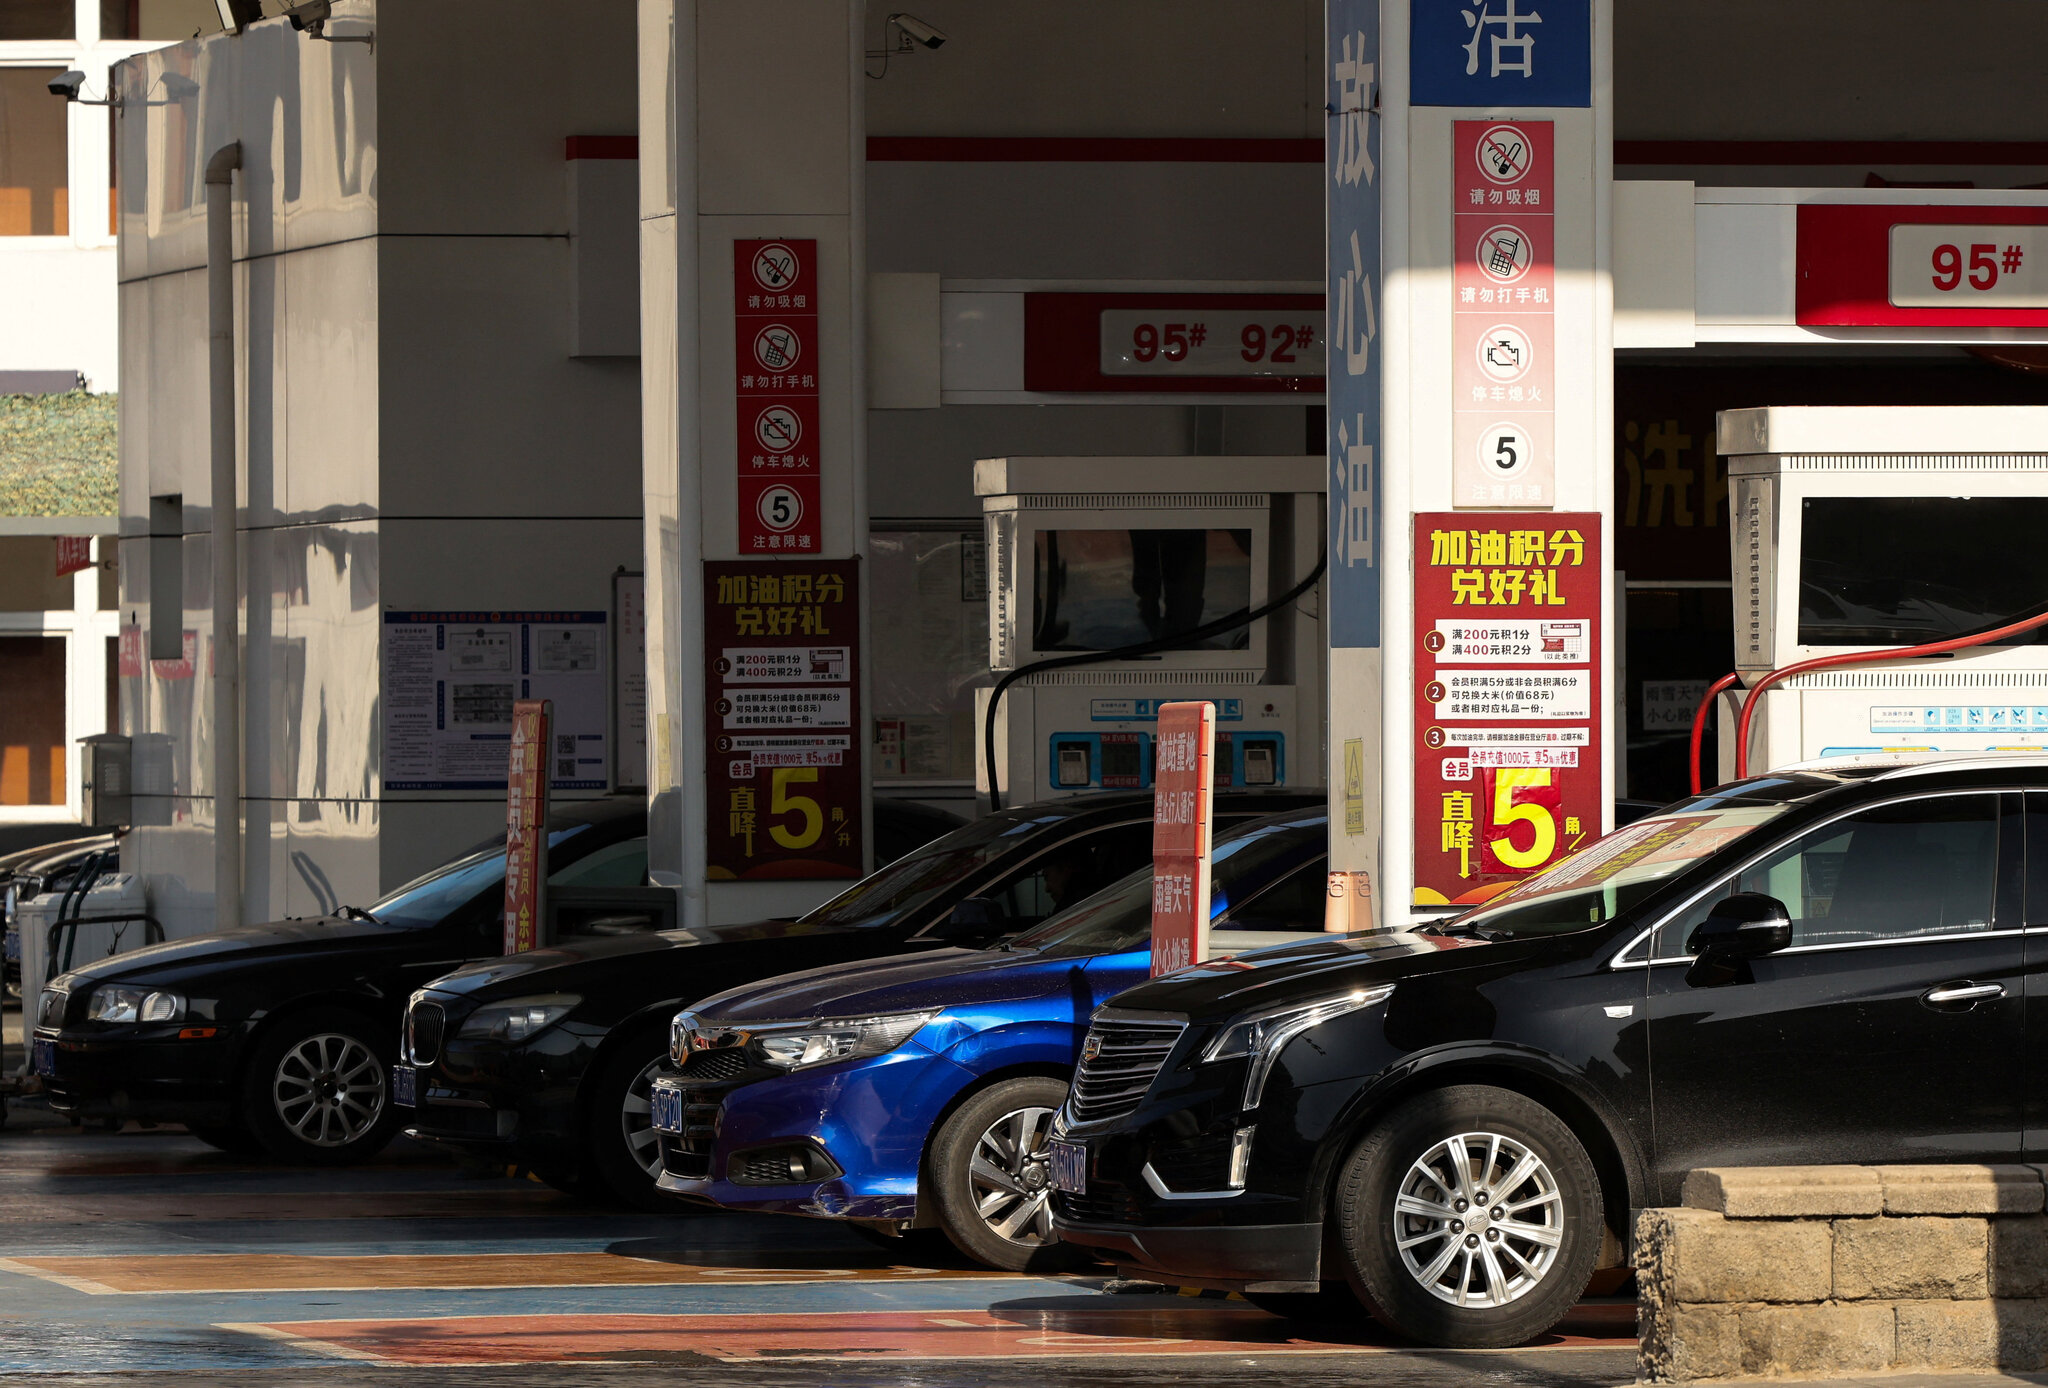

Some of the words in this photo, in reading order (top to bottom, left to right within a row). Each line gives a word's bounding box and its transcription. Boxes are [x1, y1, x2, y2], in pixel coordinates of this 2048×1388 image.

[1470, 188, 1541, 206] 请勿吸烟
[1931, 243, 2024, 291] 95#
[747, 293, 807, 309] 请勿吸烟
[1335, 30, 1376, 568] 放心油
[1460, 286, 1550, 304] 请勿打手机
[1133, 323, 1207, 363] 95#
[1241, 324, 1314, 363] 92#
[742, 374, 816, 390] 请勿打手机
[1471, 385, 1543, 403] 停车熄火
[751, 453, 811, 470] 停车熄火
[1495, 436, 1517, 470] 5
[1471, 484, 1544, 501] 注意限速
[772, 496, 790, 523] 5
[752, 532, 812, 549] 注意限速
[1430, 529, 1586, 567] 加油积分
[717, 573, 845, 605] 加油积分
[1451, 568, 1568, 605] 兑好礼
[735, 606, 831, 636] 兑好礼
[1451, 630, 1531, 641] 满200元积1分
[1451, 645, 1533, 656] 满400元积2分
[736, 655, 801, 665] 满200元积1分
[736, 667, 803, 678] 满400元积2分
[1450, 677, 1578, 688] 会员积满5分或非会员积满6分
[1450, 690, 1555, 702] 可兑换大米(价值68元)
[1646, 706, 1699, 723] 小心路
[1470, 751, 1530, 765] 会员充值1000元
[732, 763, 753, 777] 会员
[1445, 761, 1470, 778] 会员
[769, 767, 823, 849] 5
[729, 786, 757, 859] 直降
[1489, 768, 1557, 869] 5
[1441, 790, 1473, 879] 直降
[1154, 873, 1193, 916] 雨雪天气
